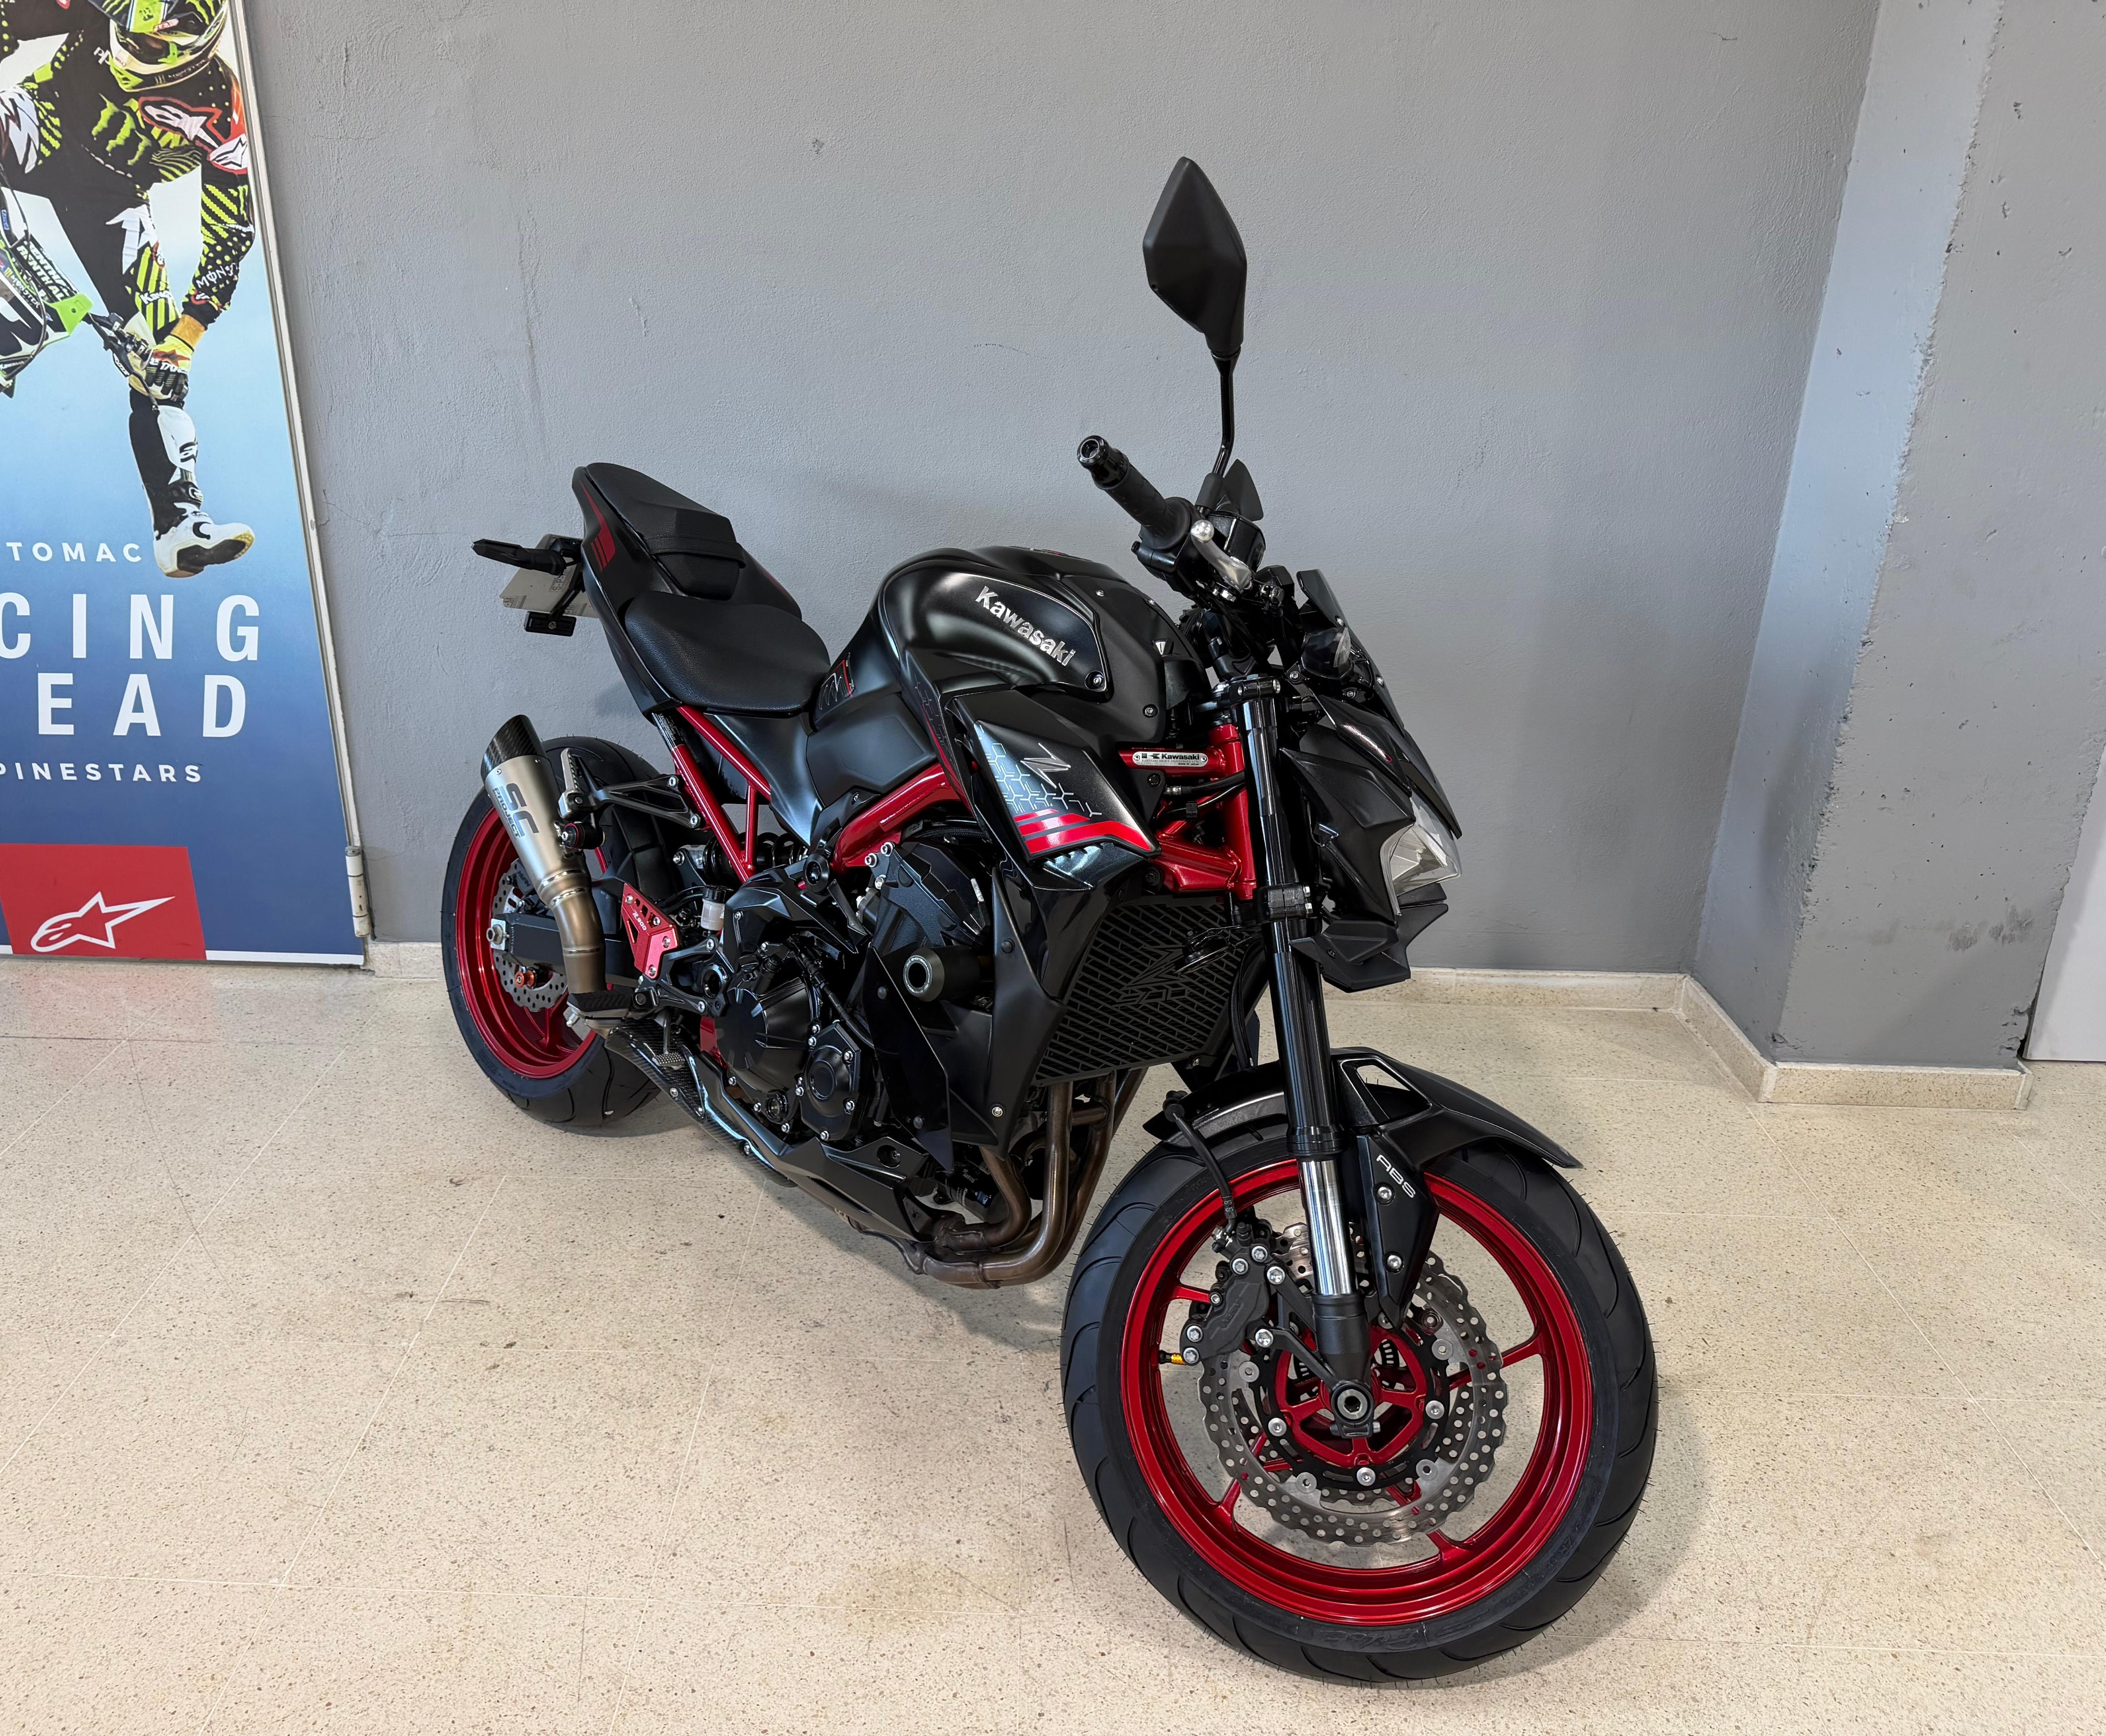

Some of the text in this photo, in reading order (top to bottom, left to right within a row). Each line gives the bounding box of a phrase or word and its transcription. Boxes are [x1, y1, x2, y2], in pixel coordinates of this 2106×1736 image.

[6, 542, 142, 562] TOMAC
[0, 592, 259, 662] CING
[975, 585, 1076, 666] Kawasaki
[38, 673, 246, 738] EAD
[492, 787, 521, 838] PROJECT
[499, 783, 539, 837] SC
[1376, 1154, 1416, 1198] ABS
